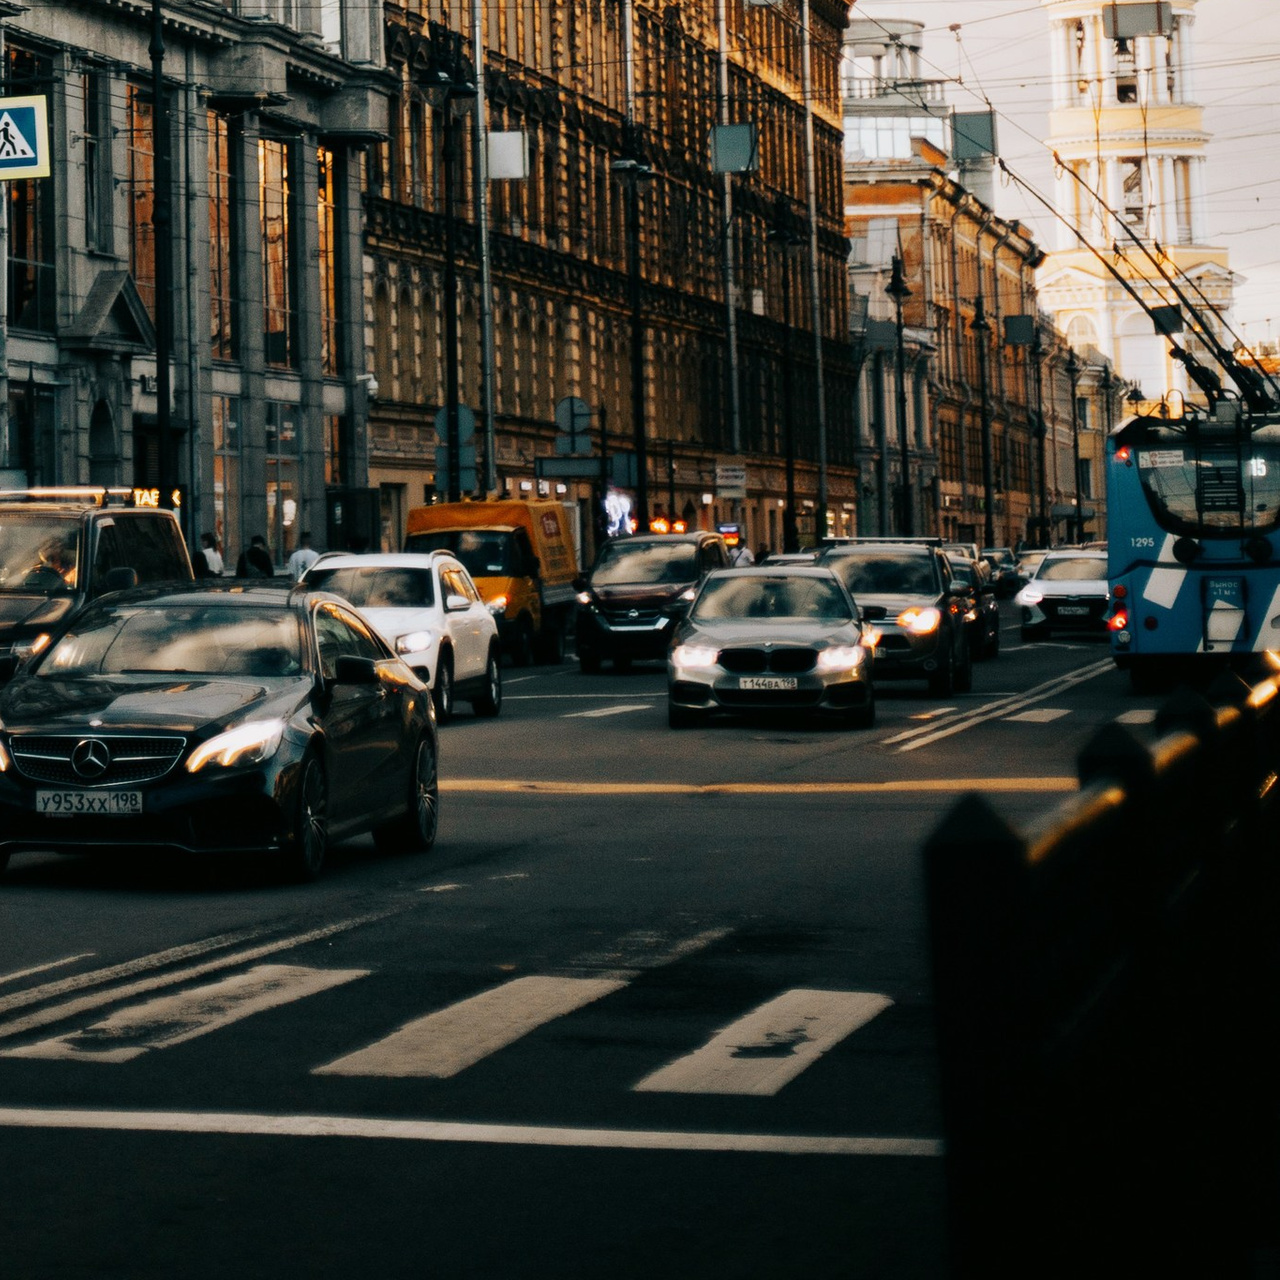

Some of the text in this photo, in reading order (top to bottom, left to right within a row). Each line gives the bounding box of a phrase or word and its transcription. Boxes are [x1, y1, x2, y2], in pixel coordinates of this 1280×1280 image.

[1250, 458, 1267, 476] 15
[1130, 537, 1155, 547] 1295
[41, 793, 138, 812] У953ХХ 198
